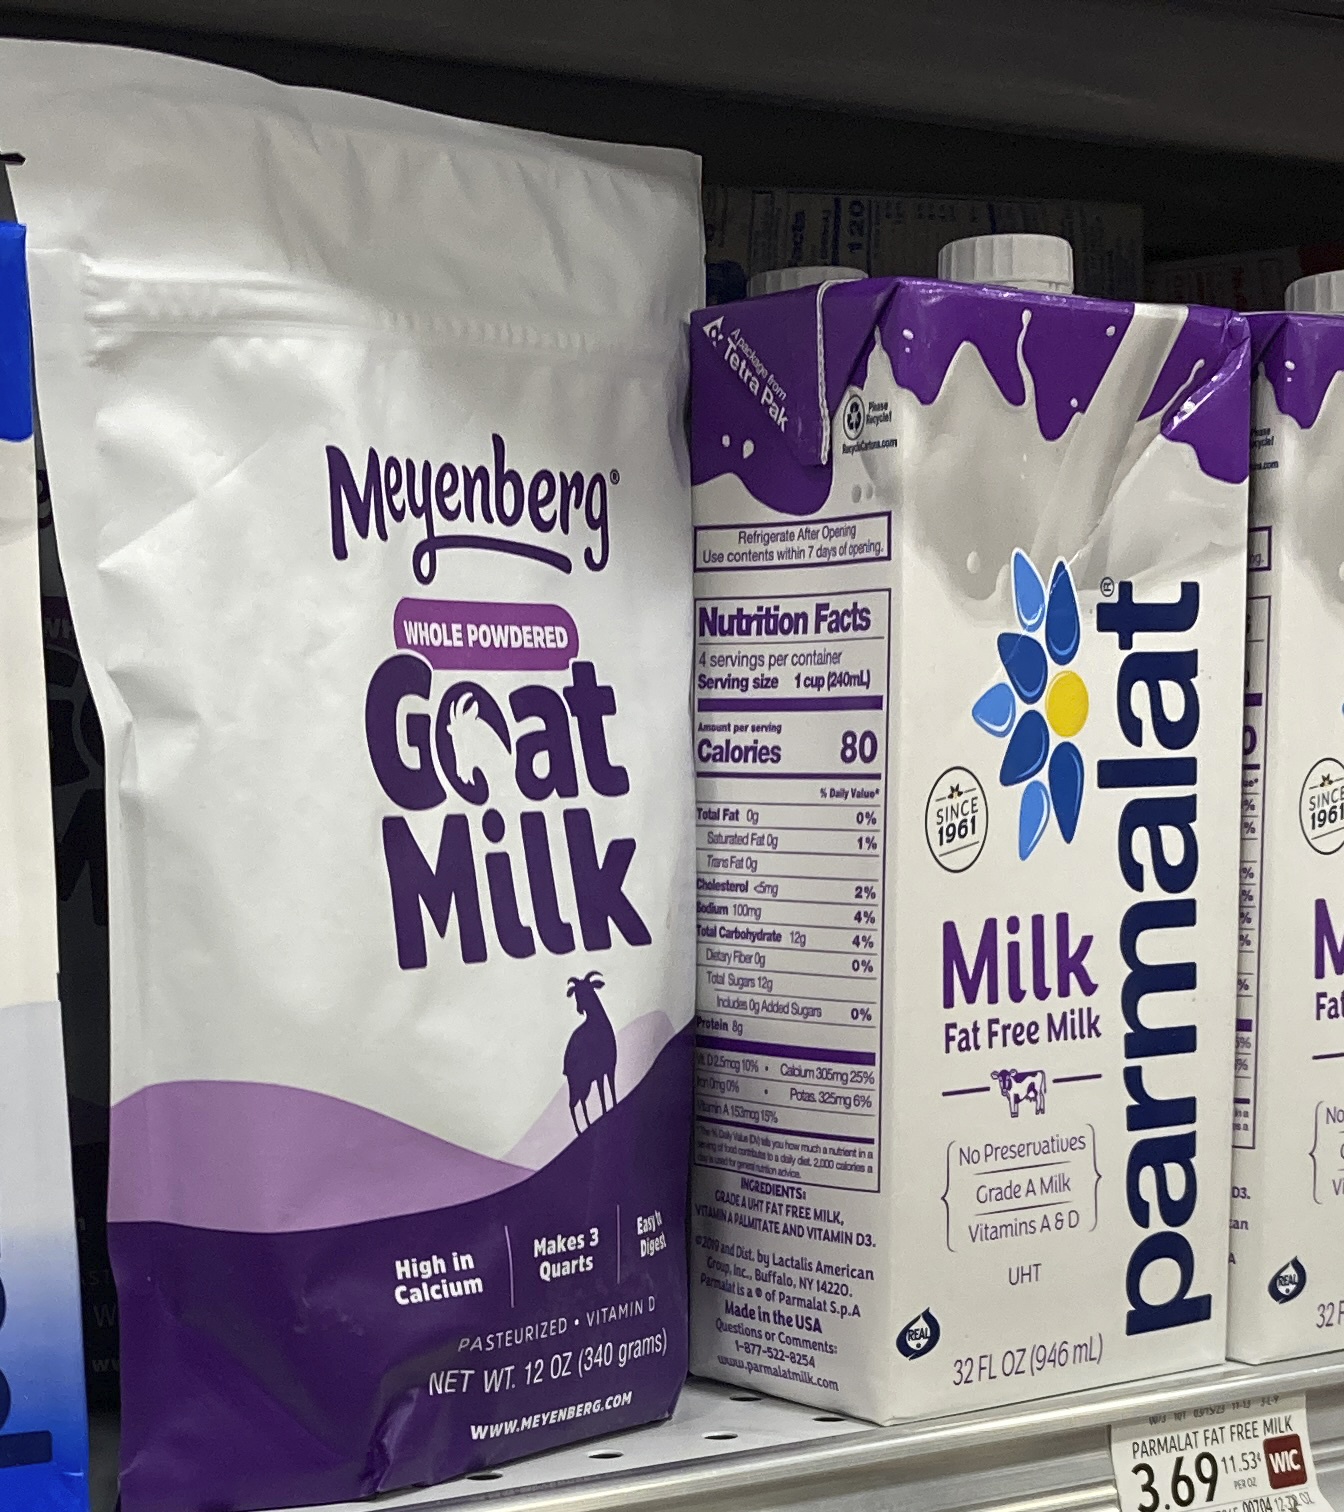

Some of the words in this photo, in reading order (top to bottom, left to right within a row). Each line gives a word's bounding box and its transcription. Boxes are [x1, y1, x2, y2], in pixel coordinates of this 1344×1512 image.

[325, 433, 610, 586] Meyenberg
[738, 530, 795, 545] Refrigerate
[797, 528, 821, 541] After
[822, 524, 857, 541] Opening
[702, 550, 724, 564] Use
[726, 548, 774, 562] contents
[776, 546, 806, 560] within
[808, 546, 815, 558] 7
[816, 544, 837, 559] days
[838, 542, 847, 556] of
[403, 619, 463, 647] WHOLE
[467, 623, 569, 649] POWDERED
[699, 607, 808, 637] Nutrition
[815, 603, 871, 633] Facts
[365, 654, 630, 811] Goat
[698, 738, 782, 764] Calories
[840, 730, 878, 764] 80
[936, 795, 979, 826] SINCE
[938, 816, 977, 847] 1961
[382, 808, 653, 970] Milk
[942, 911, 1099, 1009] Milk
[1096, 580, 1213, 1336] parmalat
[944, 1020, 981, 1055] Fat
[988, 1017, 1039, 1049] Free
[1047, 1007, 1102, 1042] Milk
[534, 1233, 585, 1258] Makes
[589, 1227, 599, 1247] 3
[395, 1255, 446, 1280] High
[453, 1252, 475, 1270] in
[540, 1255, 593, 1282] Quarts
[1008, 1263, 1042, 1286] UHT
[394, 1276, 483, 1305] Calcium
[458, 1318, 568, 1352] PASTEURIZED
[586, 1303, 643, 1327] VITAMIN
[649, 1296, 656, 1311] D
[429, 1370, 475, 1395] NET
[484, 1366, 515, 1393] WT.
[525, 1359, 544, 1385] 12
[550, 1352, 572, 1379] OZ
[578, 1342, 613, 1377] (340
[619, 1328, 668, 1367] grams)
[470, 1391, 633, 1440] WWW.MEYENBERG.COM
[1132, 1431, 1199, 1459] PARMALAT
[1204, 1426, 1225, 1446] FAT
[1230, 1421, 1259, 1442] FREE
[1263, 1415, 1293, 1436] MILK
[1269, 1449, 1301, 1473] WIC
